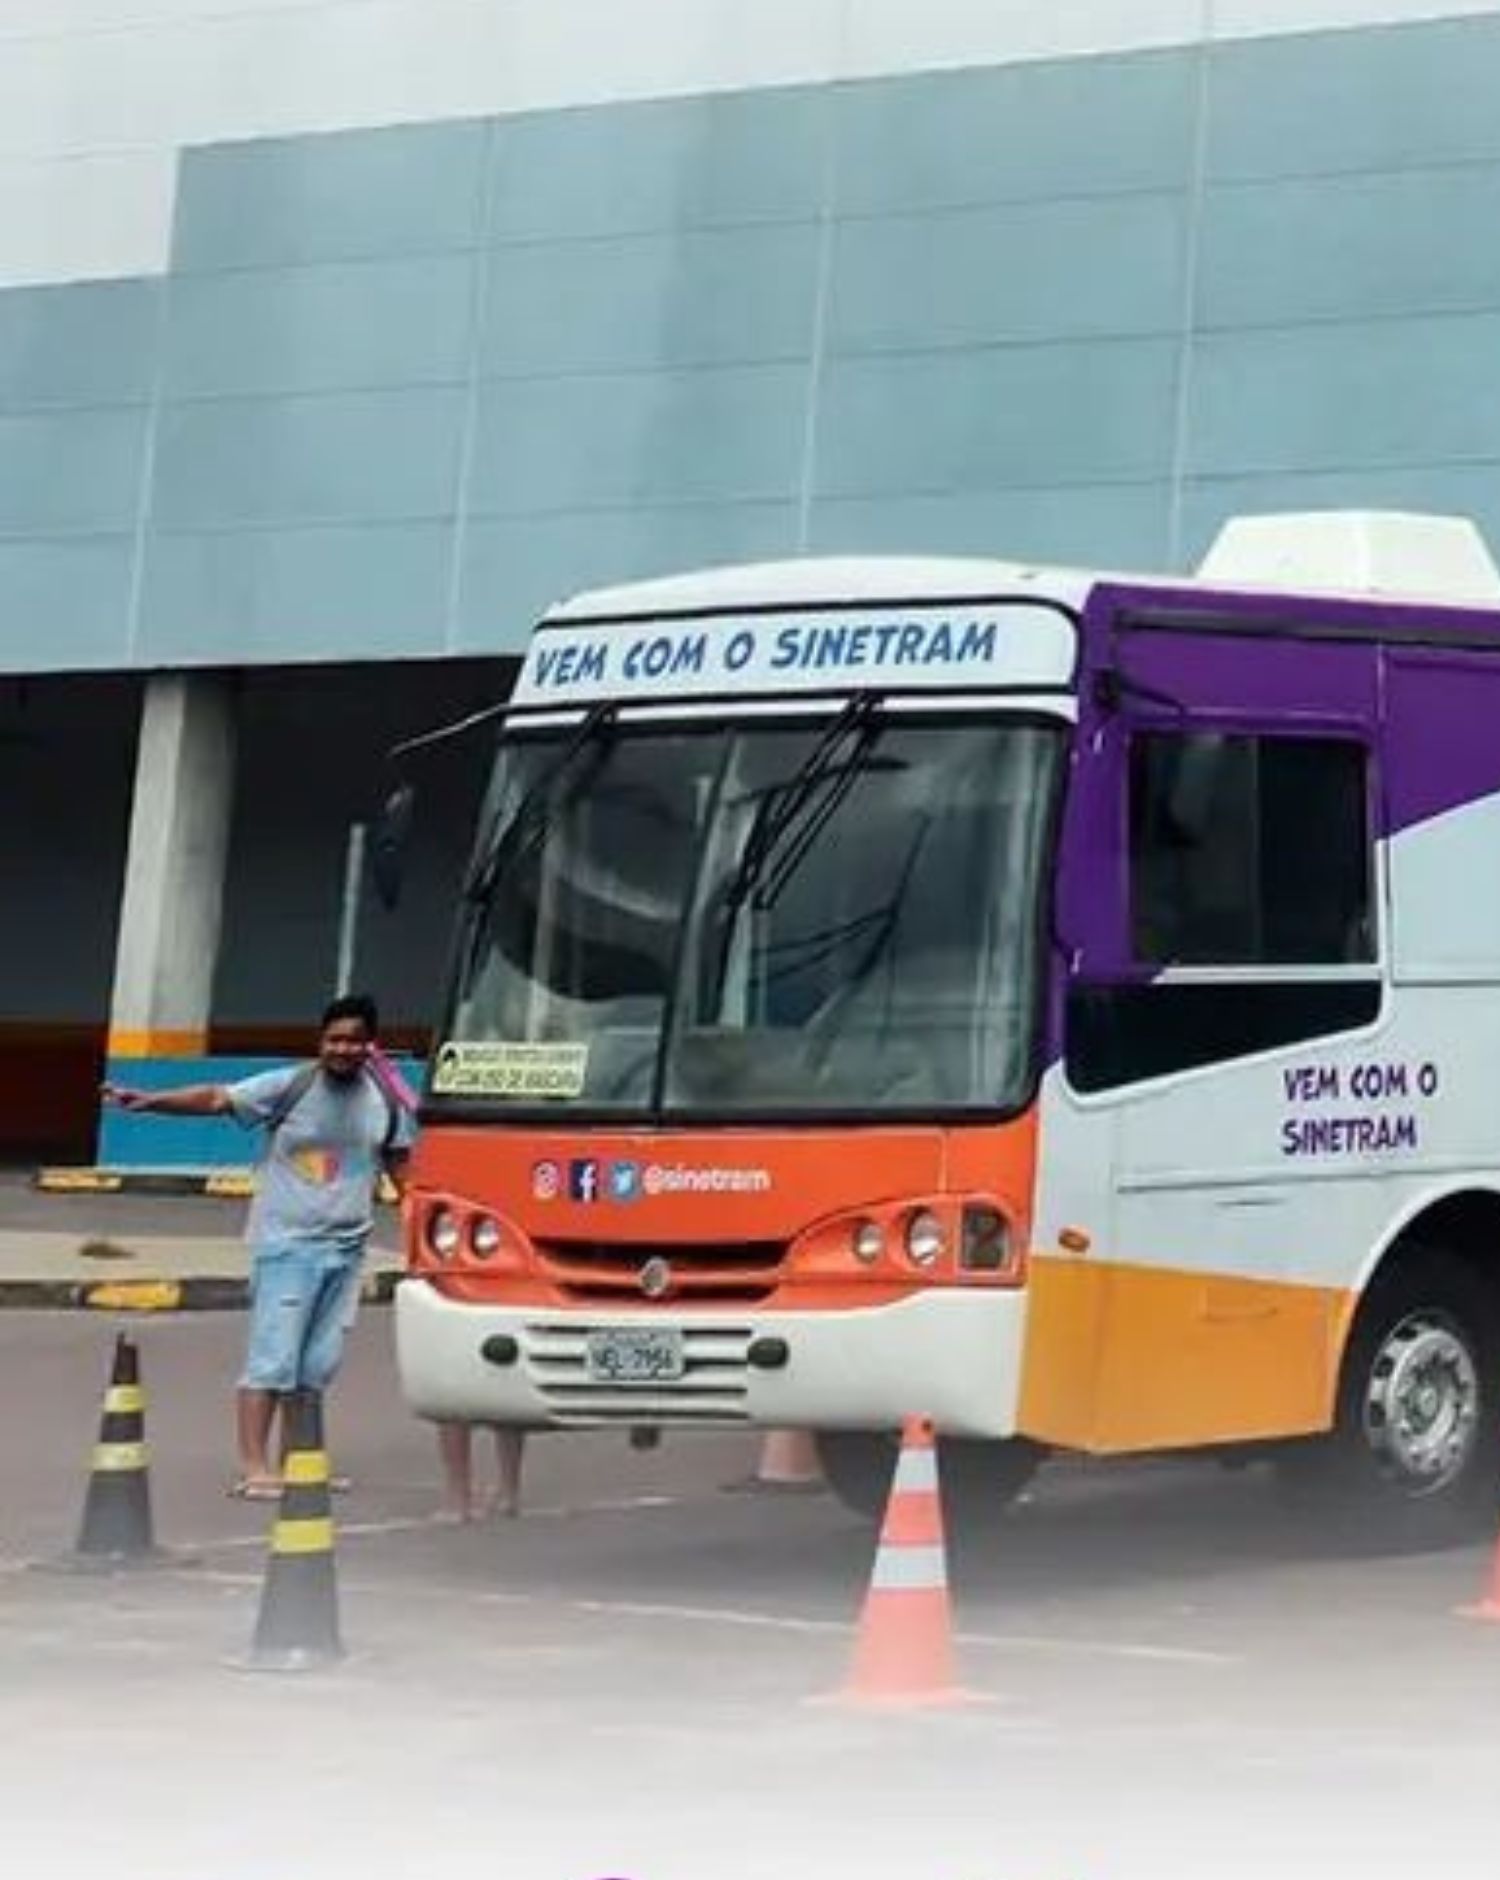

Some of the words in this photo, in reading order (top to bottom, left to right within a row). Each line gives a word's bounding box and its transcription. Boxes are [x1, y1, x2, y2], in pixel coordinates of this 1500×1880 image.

[533, 645, 606, 687] VEM
[622, 634, 706, 677] COM
[724, 629, 757, 671] O
[771, 623, 997, 667] SINETRAM
[1283, 1066, 1341, 1101] VEM
[1350, 1063, 1408, 1099] COM
[1417, 1062, 1439, 1097] O
[1282, 1115, 1417, 1155] SINETRAM
